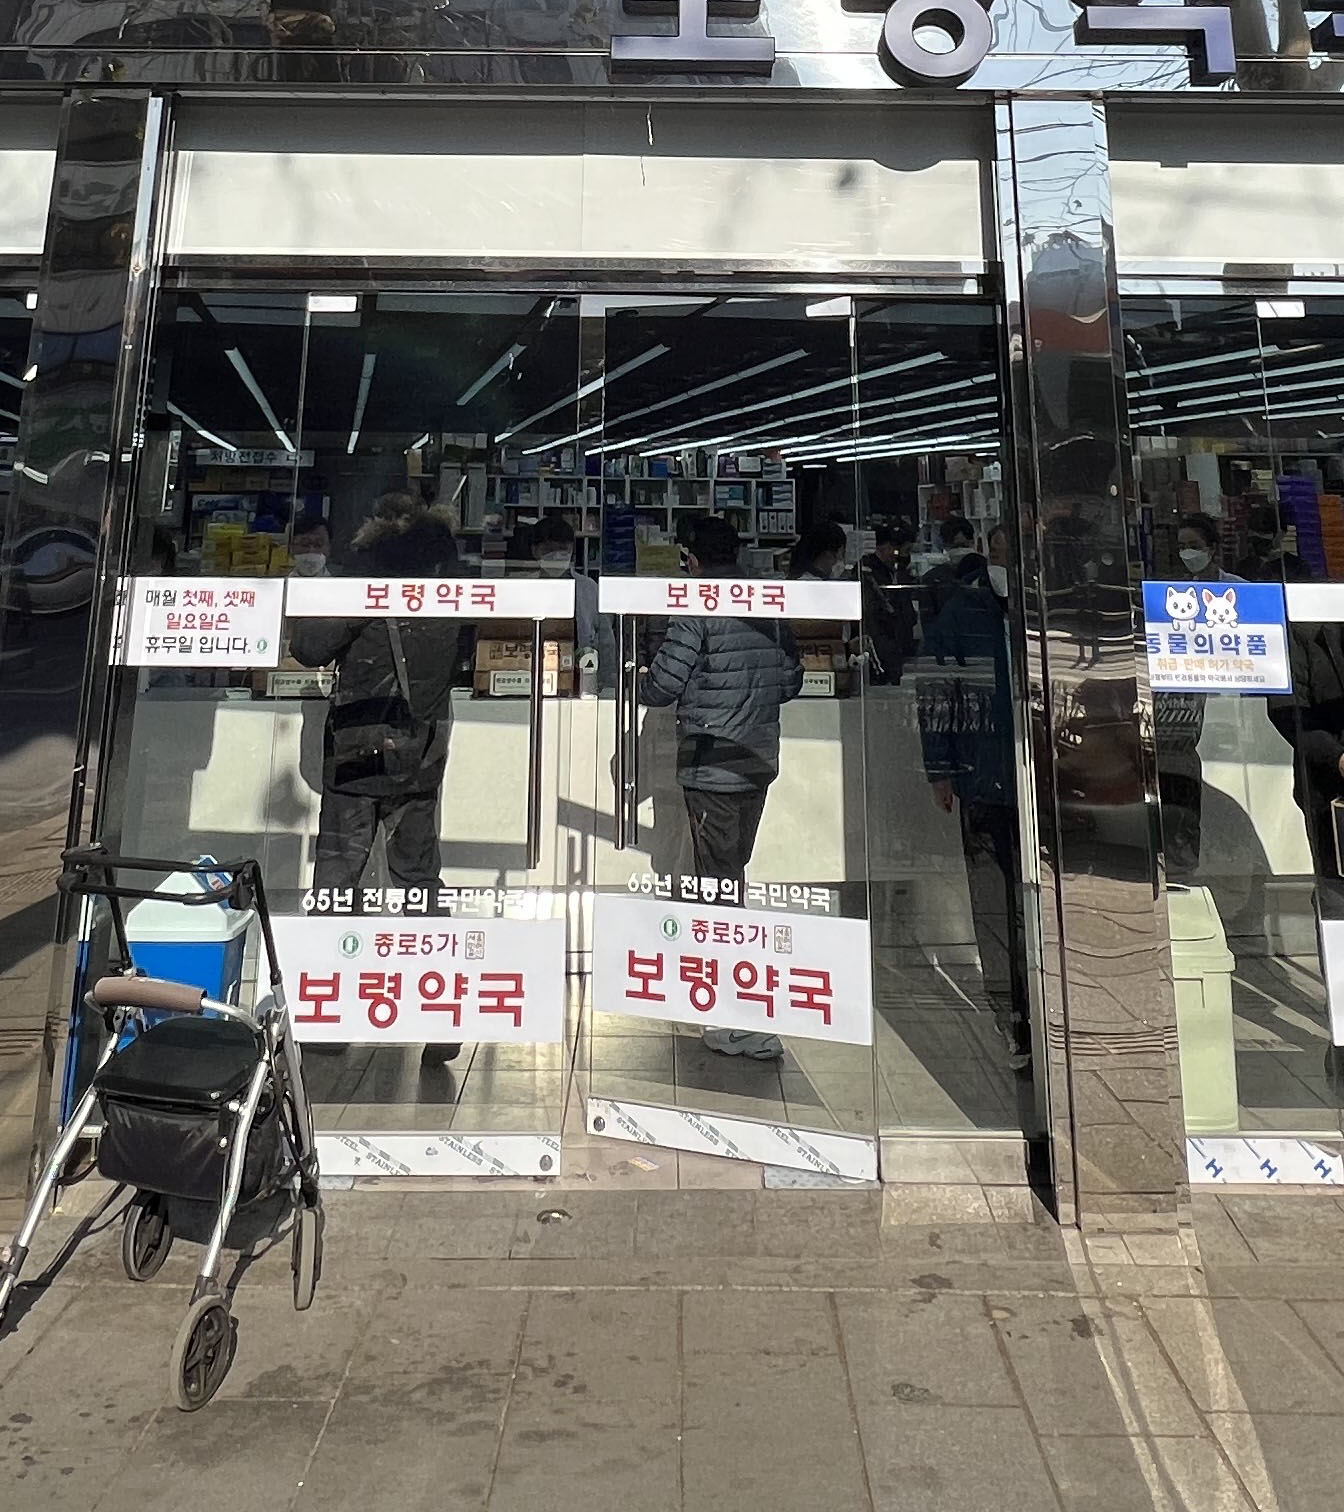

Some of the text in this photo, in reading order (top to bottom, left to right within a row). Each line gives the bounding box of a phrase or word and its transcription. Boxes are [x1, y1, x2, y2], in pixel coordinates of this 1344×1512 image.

[145, 589, 177, 607] 매월
[182, 589, 218, 608] 첫째,
[223, 590, 256, 607] 셋째
[364, 584, 497, 612] 보령약국
[667, 582, 786, 612] 보령약국
[166, 612, 231, 630] 일요일은
[144, 635, 252, 655] 휴무일 입니다.
[301, 888, 353, 913] 65년
[627, 871, 673, 898] 65년
[747, 880, 831, 912] 국민약국
[374, 933, 459, 958] 종로5가
[691, 918, 767, 949] 종로5가
[294, 971, 526, 1028] 보령약국
[625, 949, 833, 1026] 보령약국
